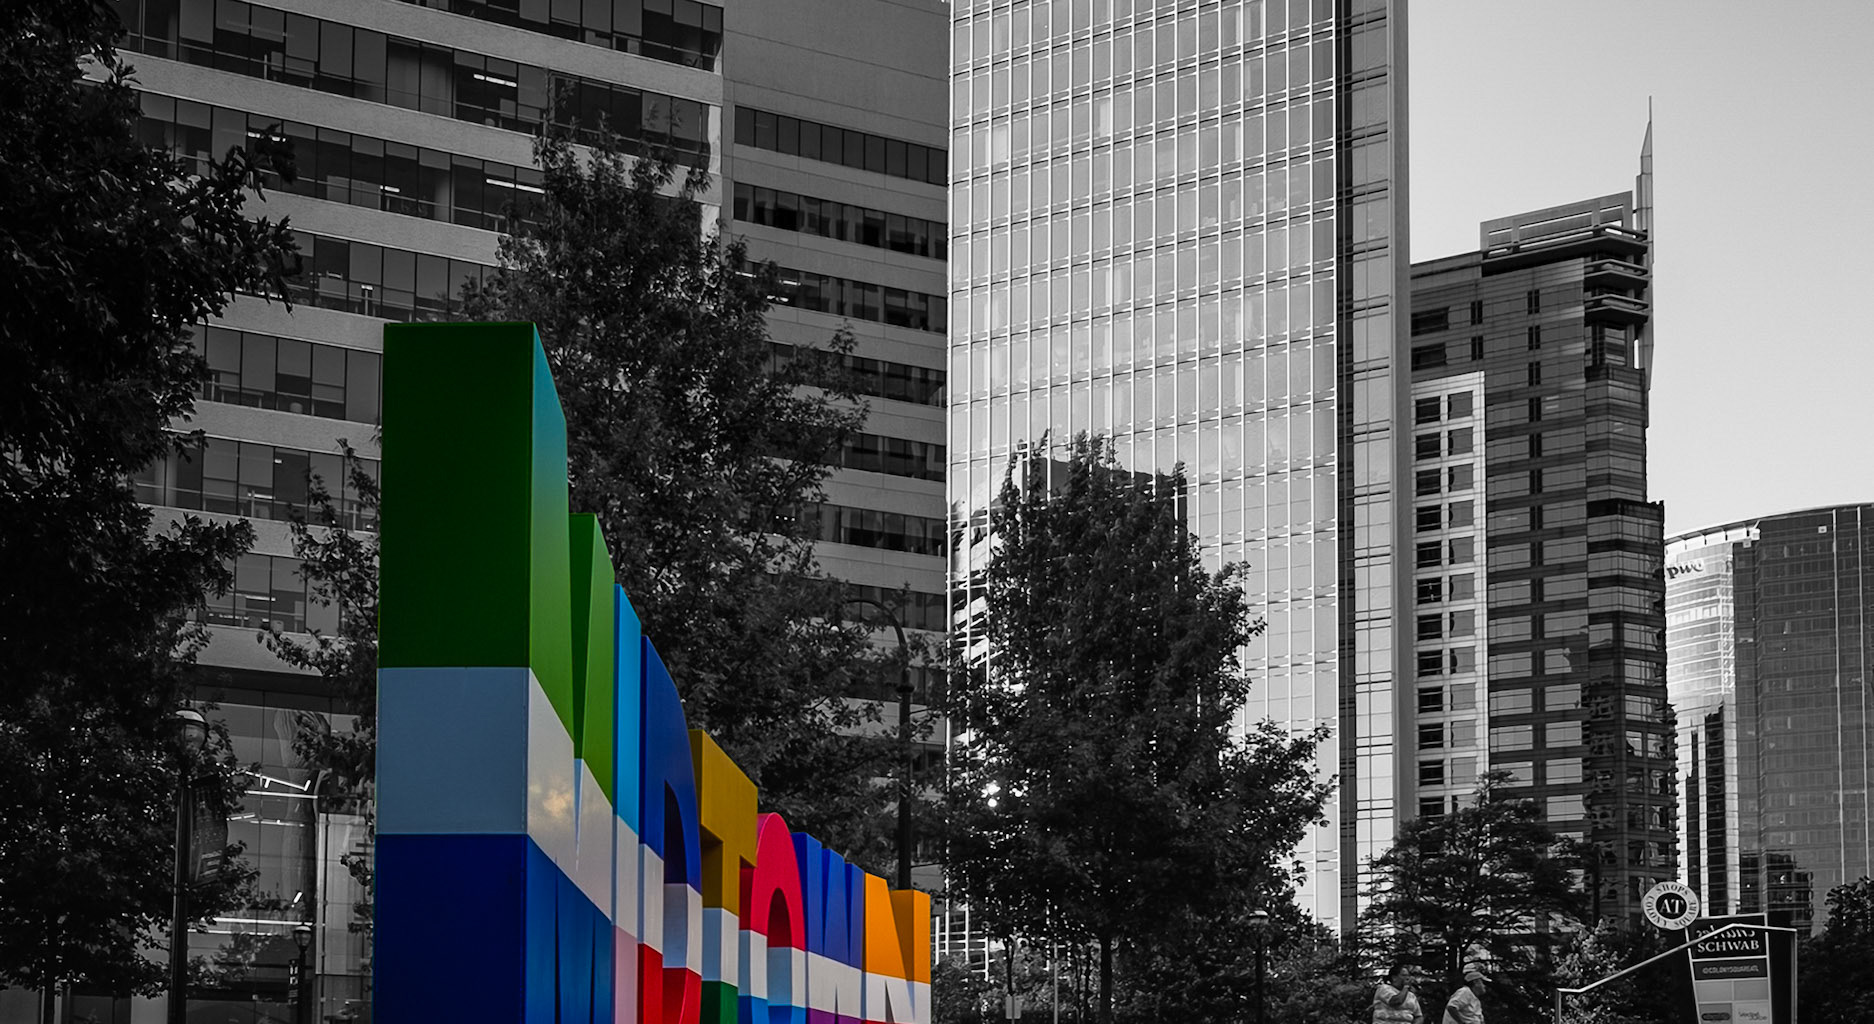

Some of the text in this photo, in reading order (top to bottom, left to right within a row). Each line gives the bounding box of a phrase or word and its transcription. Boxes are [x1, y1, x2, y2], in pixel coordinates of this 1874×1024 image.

[1666, 563, 1704, 579] pwc
[1656, 884, 1689, 896] SHOPS
[1646, 896, 1697, 928] COLONY SQUARE
[1659, 899, 1684, 914] AT
[1697, 940, 1760, 953] SCHWAB
